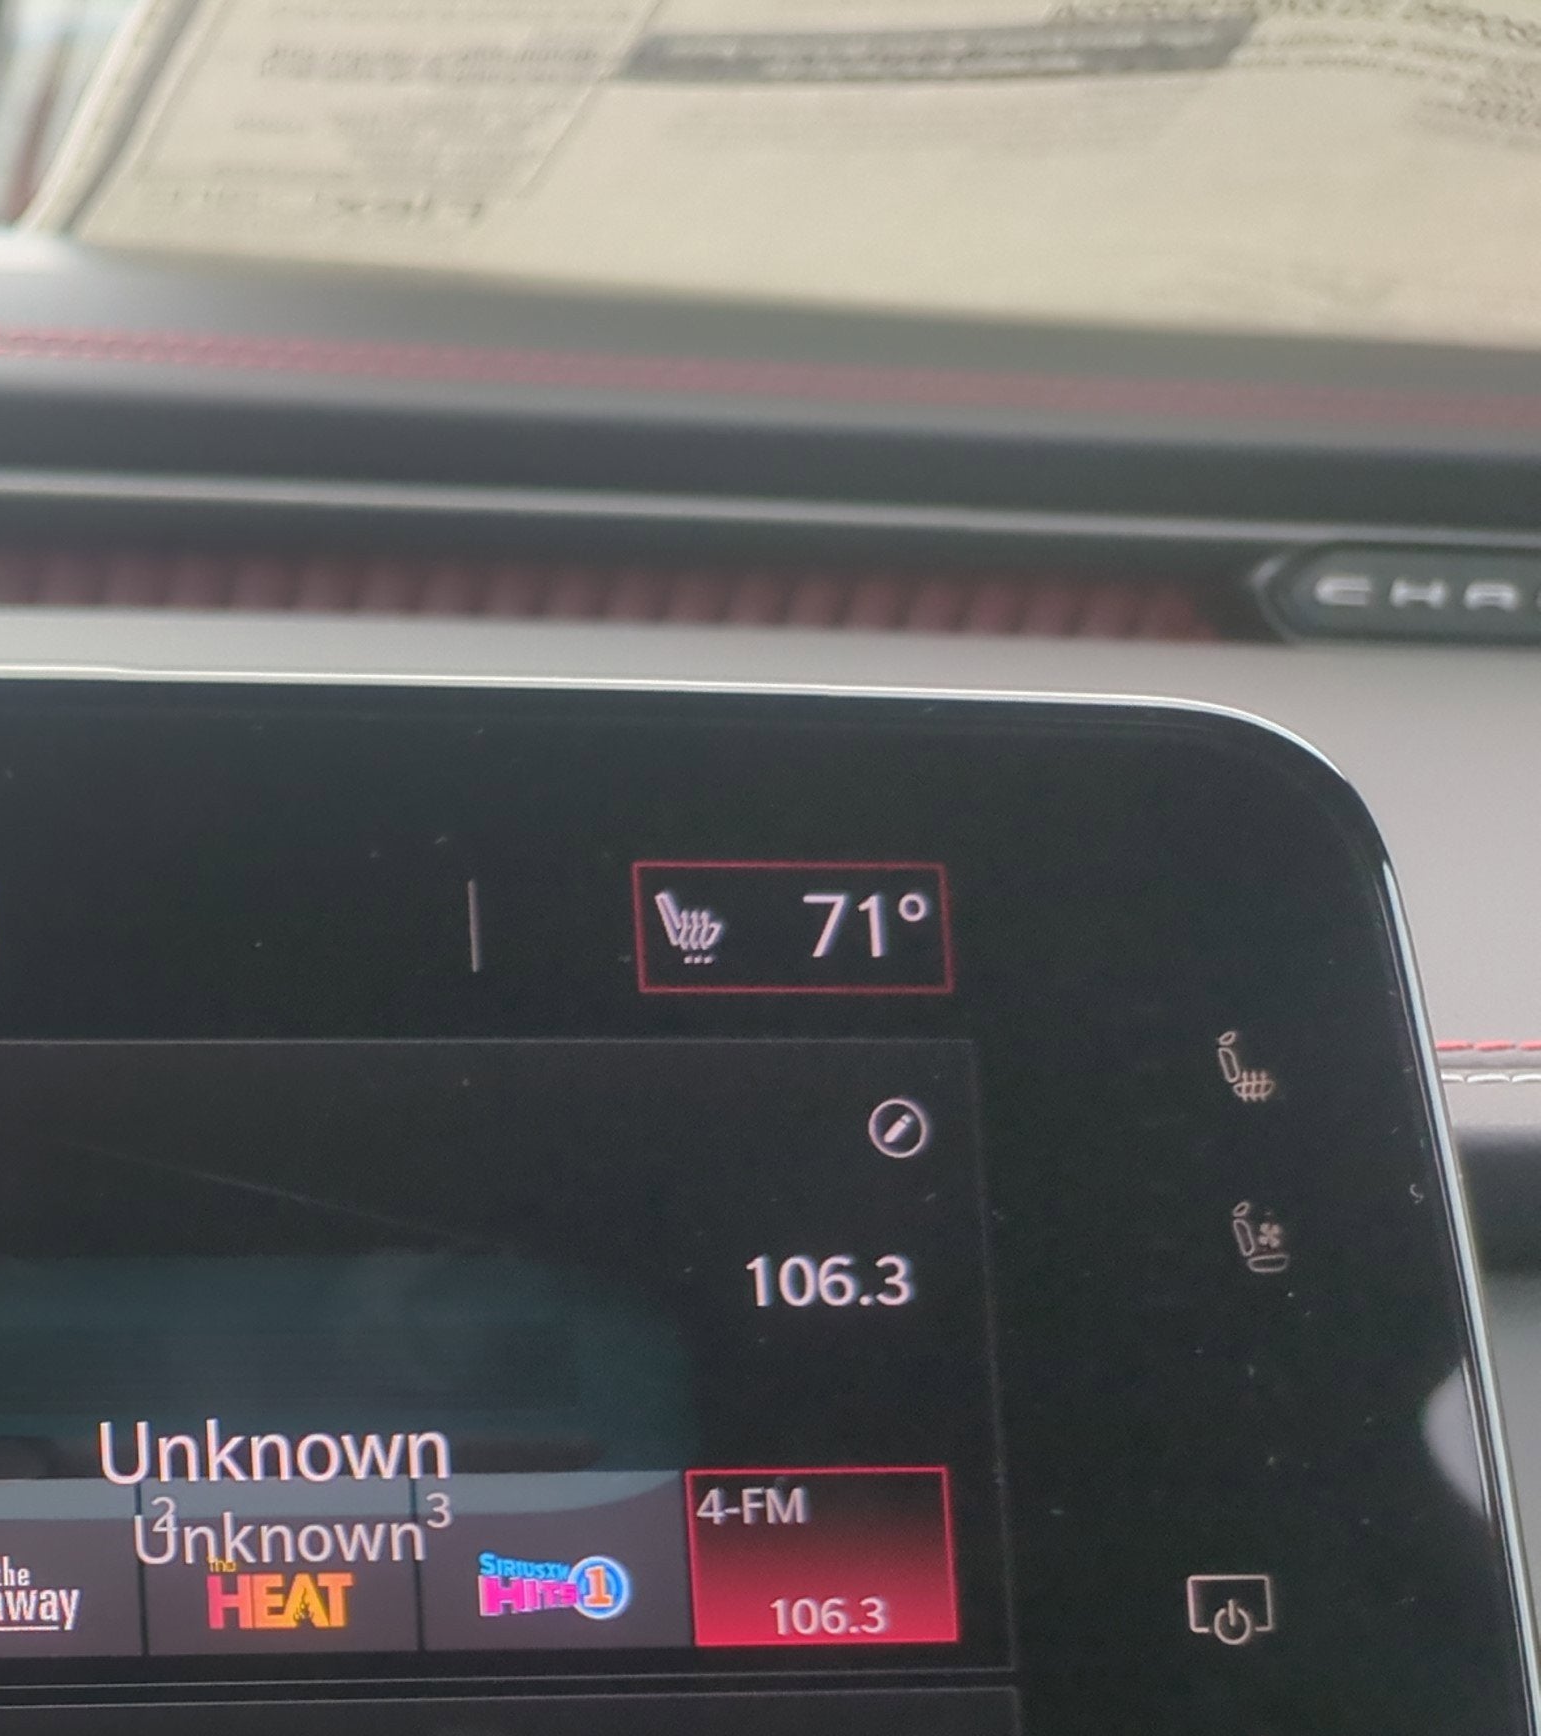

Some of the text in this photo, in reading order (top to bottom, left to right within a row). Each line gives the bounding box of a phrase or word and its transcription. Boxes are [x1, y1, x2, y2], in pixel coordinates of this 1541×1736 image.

[1314, 574, 1541, 612] CHA
[803, 893, 928, 958] 71°
[745, 1255, 916, 1308] 106.3
[98, 1417, 454, 1486] Unknown
[426, 1492, 454, 1530] 3
[696, 1487, 808, 1526] 4-FM
[133, 1511, 428, 1566] Unknown
[206, 1573, 355, 1630] HEAT
[584, 1565, 615, 1608] 1
[770, 1597, 888, 1636] 106.3
